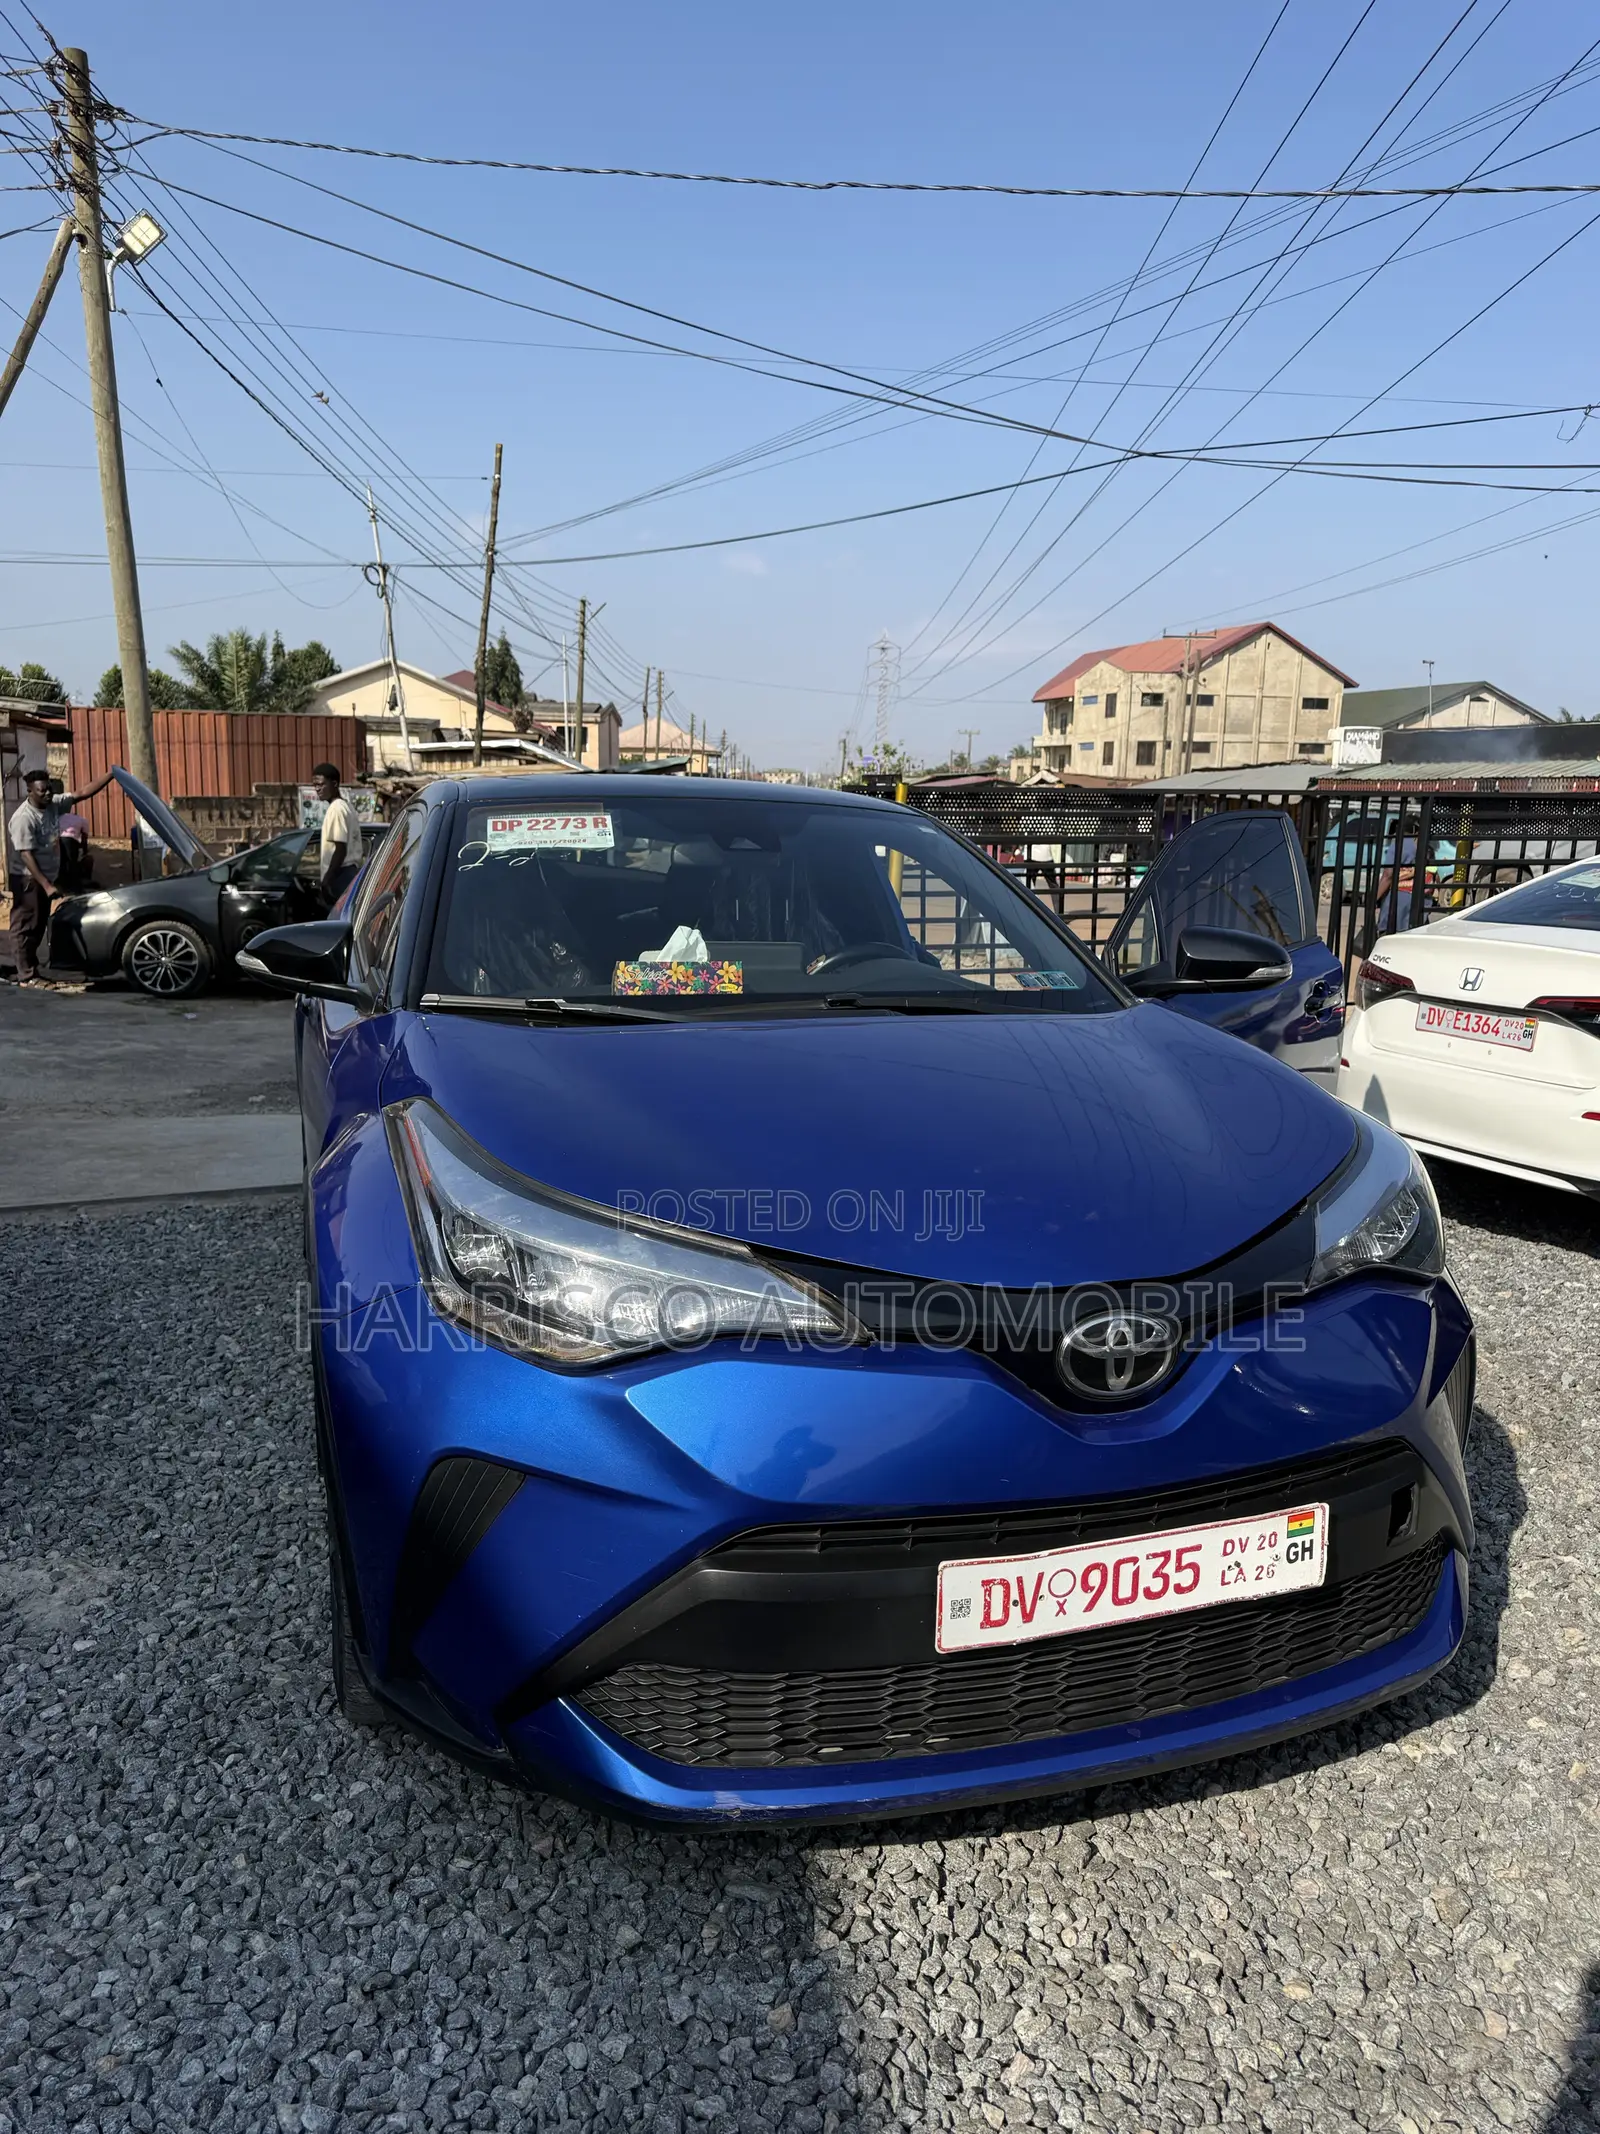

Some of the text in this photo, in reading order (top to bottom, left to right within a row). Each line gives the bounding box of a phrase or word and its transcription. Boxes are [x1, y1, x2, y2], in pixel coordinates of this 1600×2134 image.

[492, 817, 608, 832] DP 2273 R
[1426, 1007, 1502, 1037] DV E1364
[1522, 1029, 1534, 1040] GH
[1222, 1530, 1279, 1557] DV 20
[1285, 1538, 1314, 1565] GH
[980, 1544, 1203, 1630] DV 9035
[1220, 1562, 1276, 1587] LA 26
